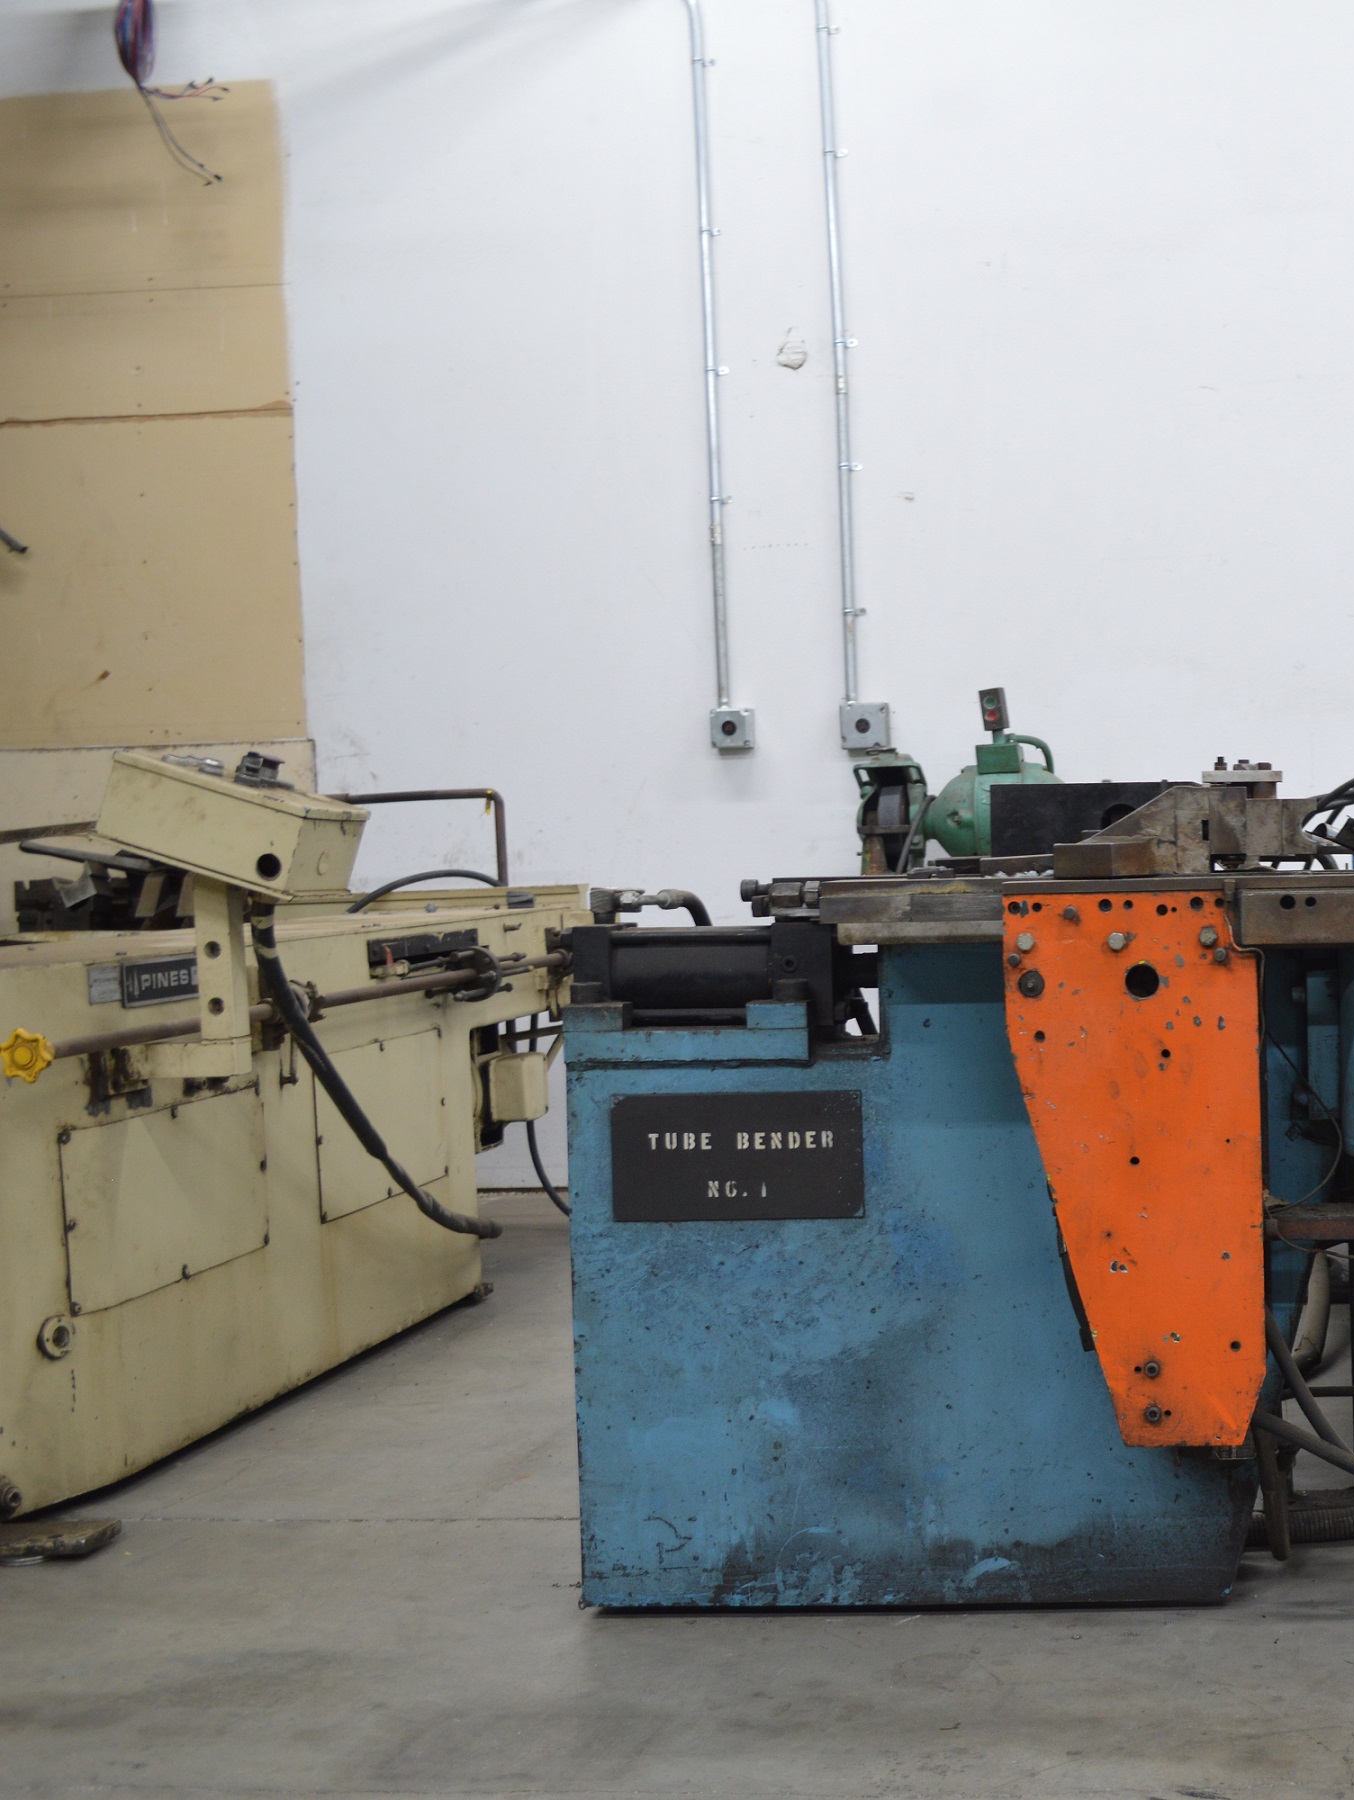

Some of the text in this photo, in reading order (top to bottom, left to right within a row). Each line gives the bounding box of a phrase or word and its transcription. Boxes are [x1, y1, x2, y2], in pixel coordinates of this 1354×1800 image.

[141, 969, 189, 991] PINES
[648, 1130, 834, 1150] TUBE BENDER
